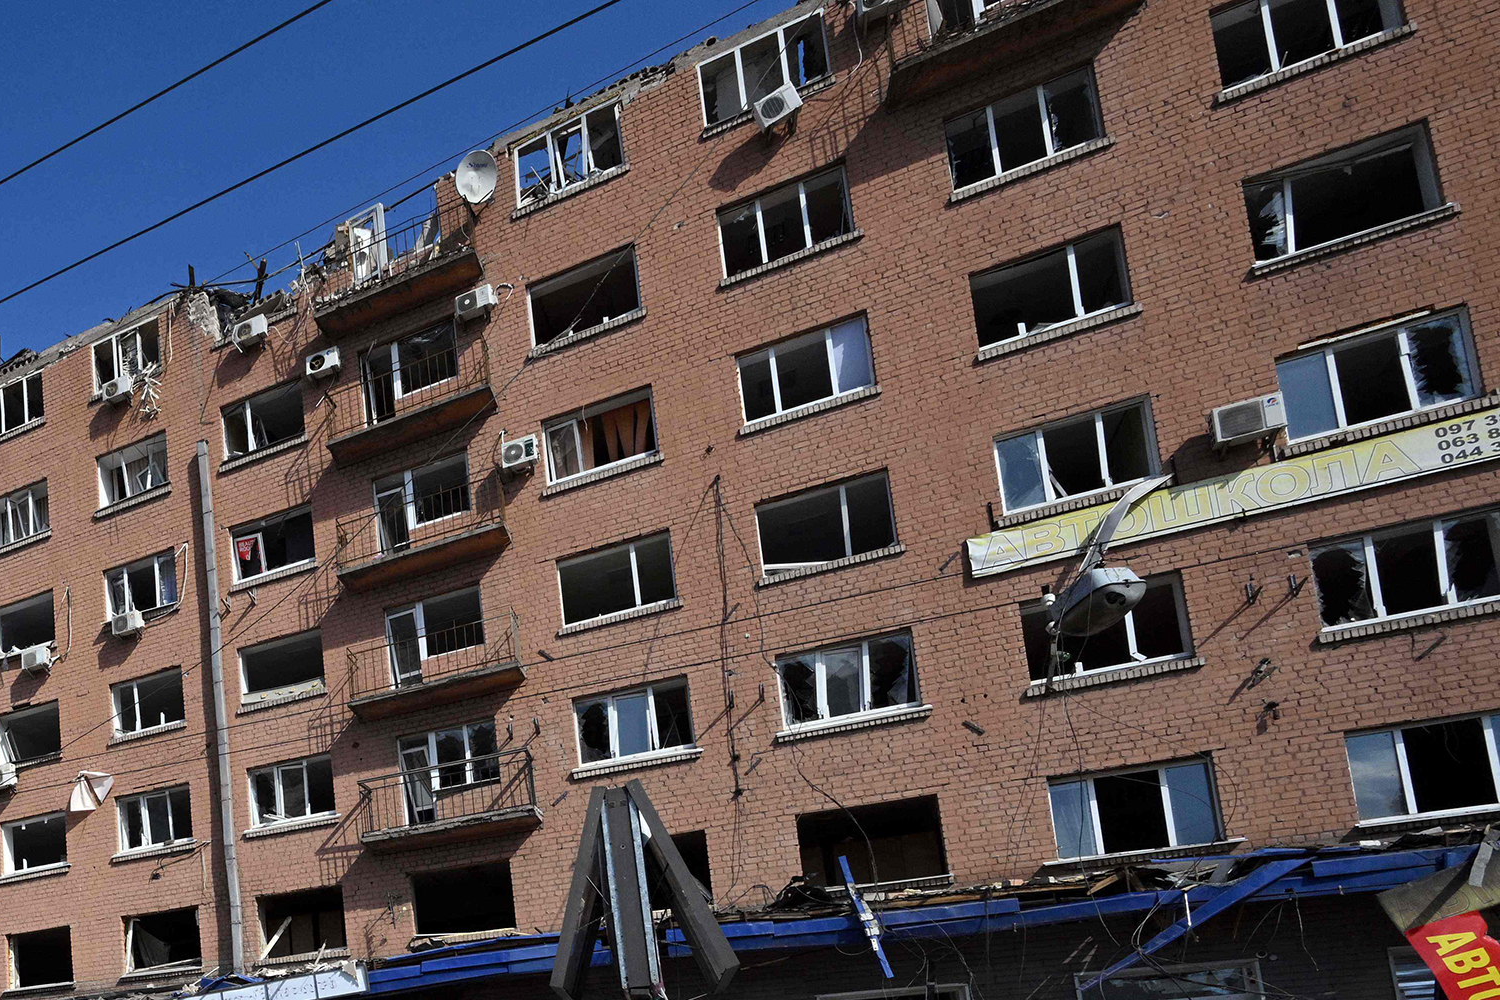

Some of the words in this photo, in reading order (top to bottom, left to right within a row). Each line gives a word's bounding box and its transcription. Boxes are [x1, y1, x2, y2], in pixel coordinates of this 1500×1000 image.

[1434, 420, 1476, 438] 097
[1484, 414, 1500, 426] 3
[1437, 433, 1480, 450] 063
[1440, 446, 1484, 463] 044
[982, 439, 1423, 572] АВТОШКОЛА
